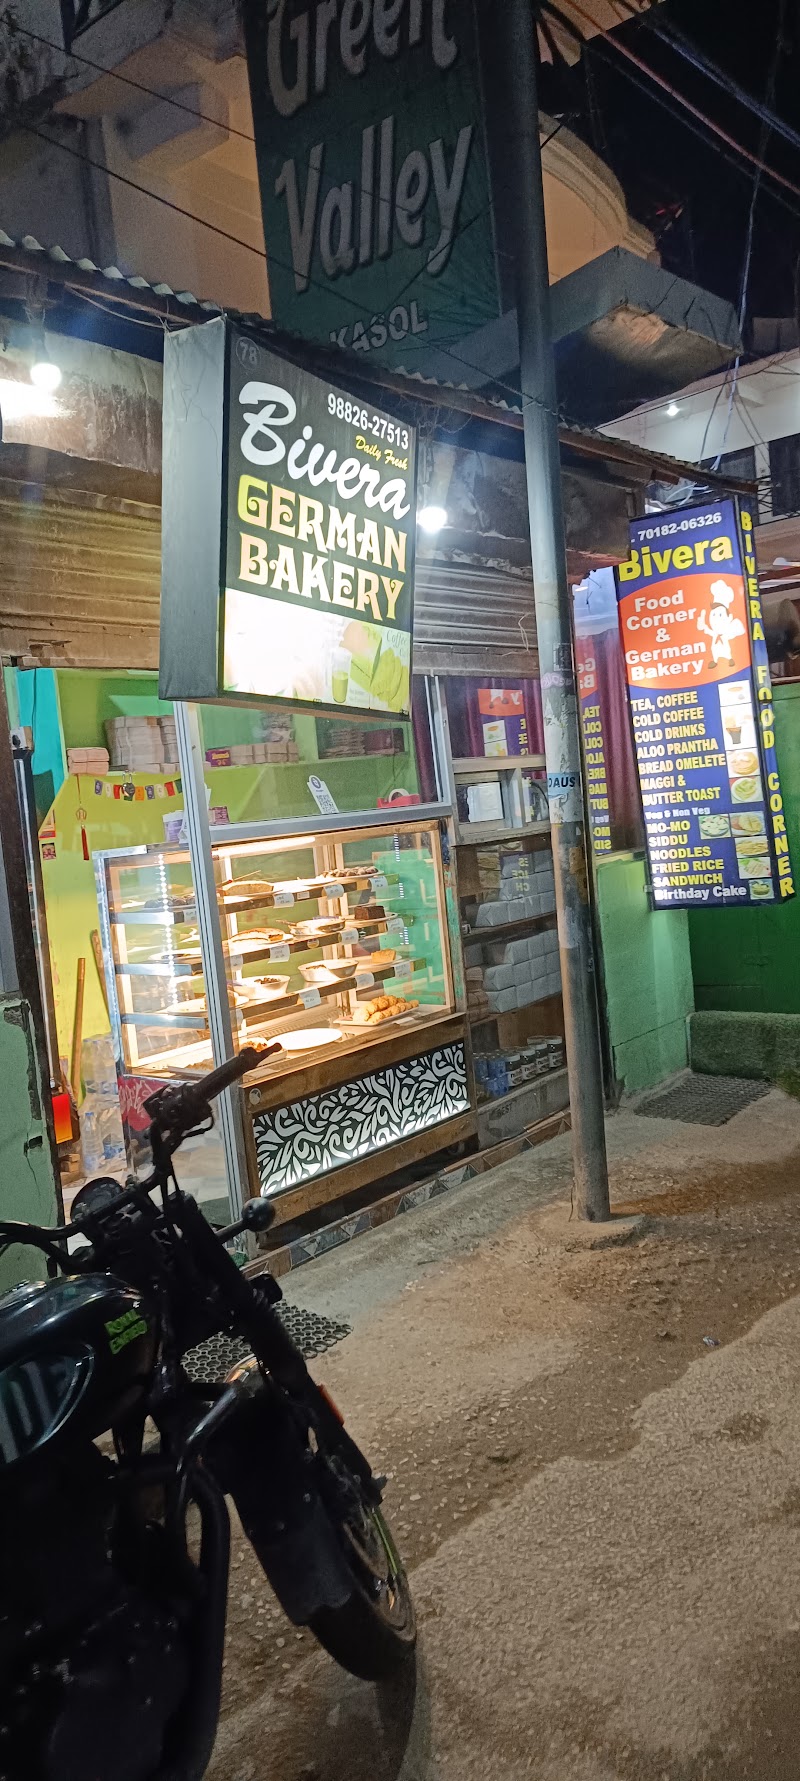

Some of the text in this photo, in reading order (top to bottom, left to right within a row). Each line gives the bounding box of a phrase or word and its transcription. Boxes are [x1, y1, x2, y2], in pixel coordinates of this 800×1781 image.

[266, 0, 457, 117] Green
[274, 114, 473, 293] Valley
[329, 300, 428, 352] KASOL
[239, 340, 258, 364] 78
[327, 392, 409, 450] 98826-27513
[238, 381, 411, 520] Bivera
[355, 435, 408, 470] Daily Fresh
[237, 474, 408, 574] GERMAN
[637, 512, 722, 542] 70182-06326
[618, 535, 734, 582] Bivera
[238, 532, 405, 621] BAKERY
[740, 511, 765, 641] BIVERA
[634, 590, 684, 612] Food
[626, 607, 696, 631] Corner
[655, 627, 671, 643] &
[625, 641, 706, 665] German
[630, 659, 704, 681] Bakery
[630, 691, 698, 712] TEA, COFFEE
[757, 665, 775, 749] FOOD
[632, 707, 705, 728] COLD COFFEE
[634, 723, 706, 743] COLD DRINKS
[636, 738, 719, 760] ALOO PRANTHA
[638, 753, 727, 775] BREAD OMELETE
[639, 774, 686, 791] MAGGI &
[641, 786, 721, 807] BUTTER TOAST
[672, 808, 691, 817] Non
[646, 820, 691, 834] MO-MO
[767, 772, 795, 897] CORNER
[648, 834, 688, 847] SIDDU
[649, 846, 711, 861] NOODLES
[651, 858, 725, 874] FRIED RICE
[652, 872, 723, 888] SANDWICH
[653, 885, 747, 901] Birthday Cake
